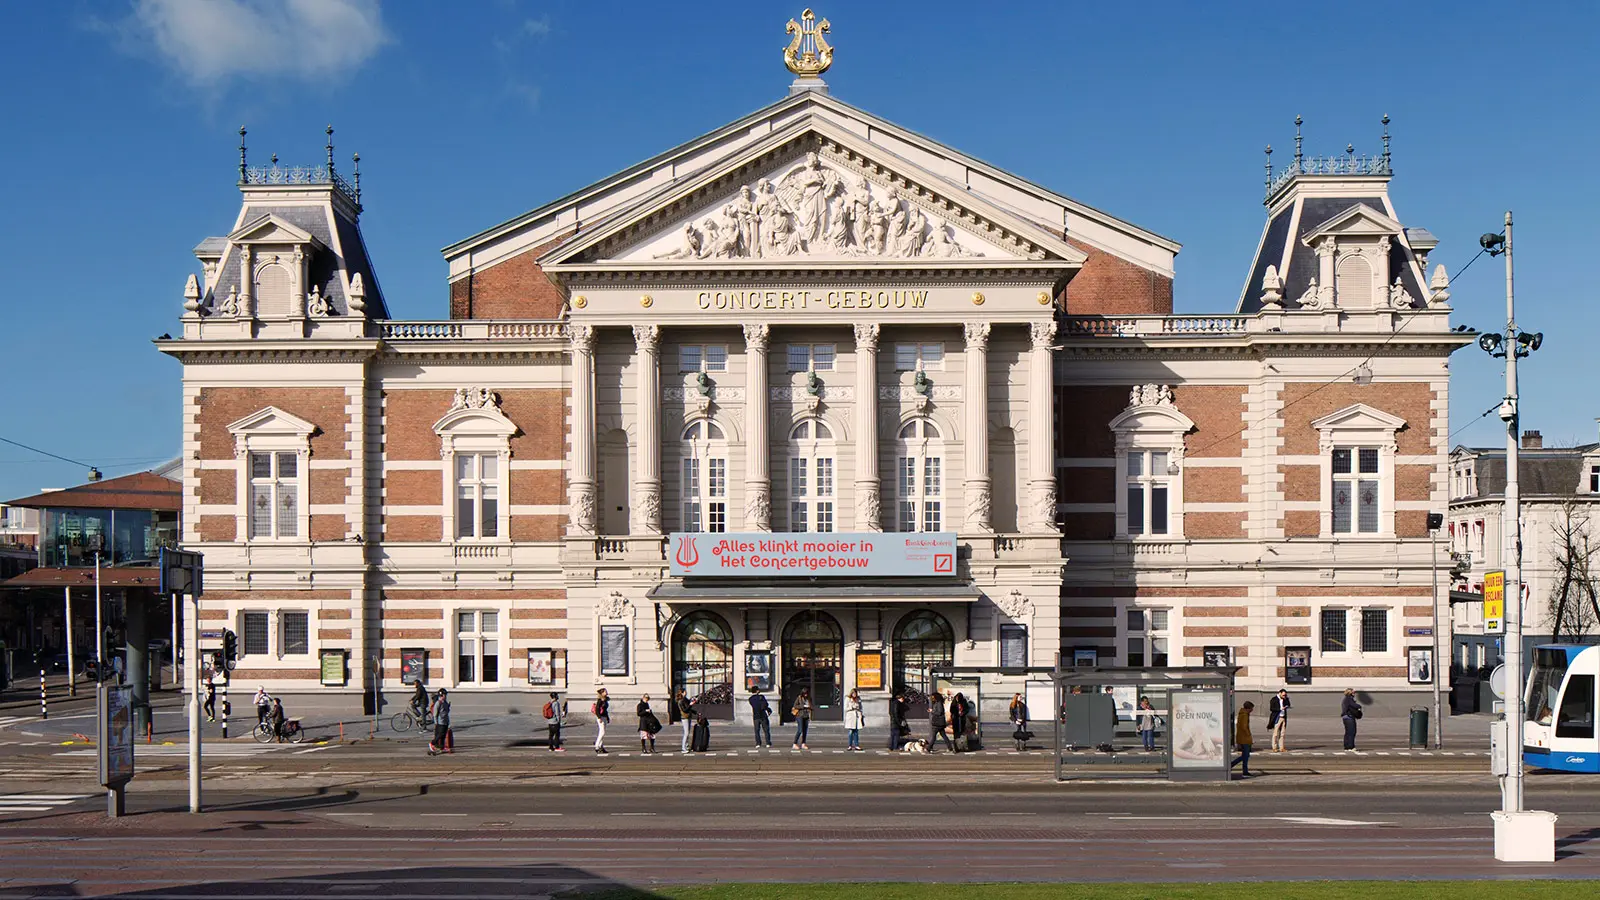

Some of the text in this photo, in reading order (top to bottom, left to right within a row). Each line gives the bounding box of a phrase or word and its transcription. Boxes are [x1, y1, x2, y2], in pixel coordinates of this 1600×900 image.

[698, 290, 928, 310] CONCERT-GEBOUW
[712, 539, 873, 556] Alles klinkt mooier in
[720, 555, 869, 571] Het Concertgebouw
[1485, 590, 1502, 602] RECLAME
[1175, 711, 1213, 720] OPEN NOW
